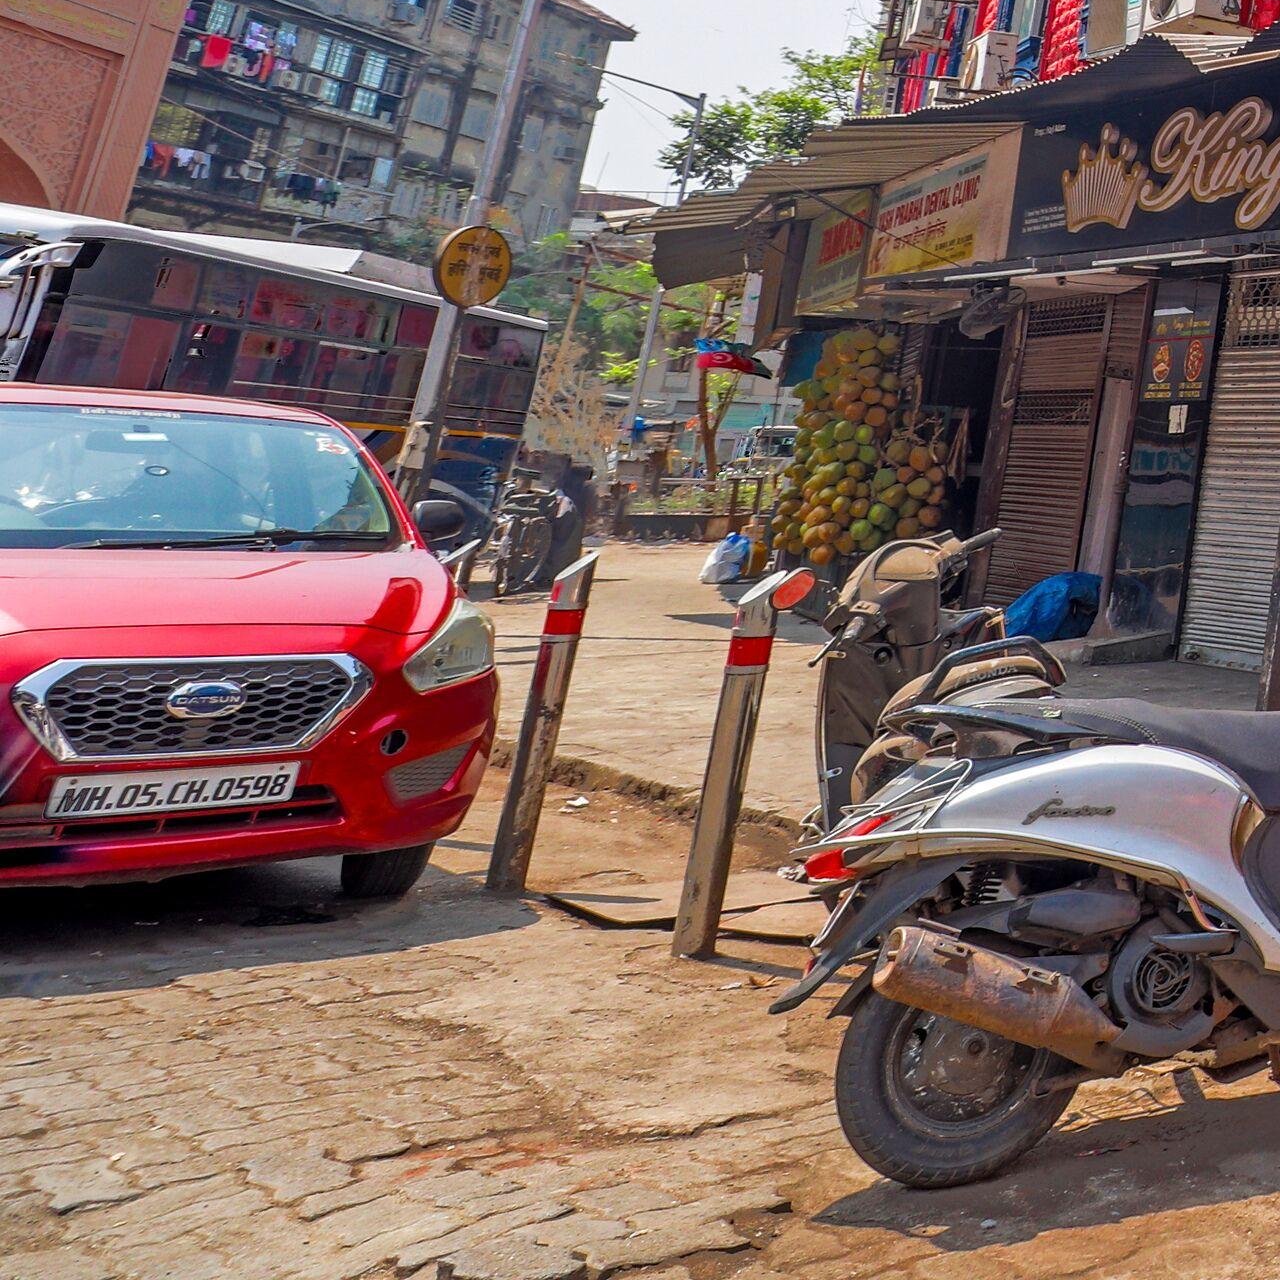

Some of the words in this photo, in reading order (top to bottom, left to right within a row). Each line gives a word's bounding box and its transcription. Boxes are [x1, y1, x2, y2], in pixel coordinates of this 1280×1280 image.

[966, 666, 1018, 683] HONDA
[176, 694, 241, 705] DATSUN
[56, 773, 288, 814] MH.05.CH.0598
